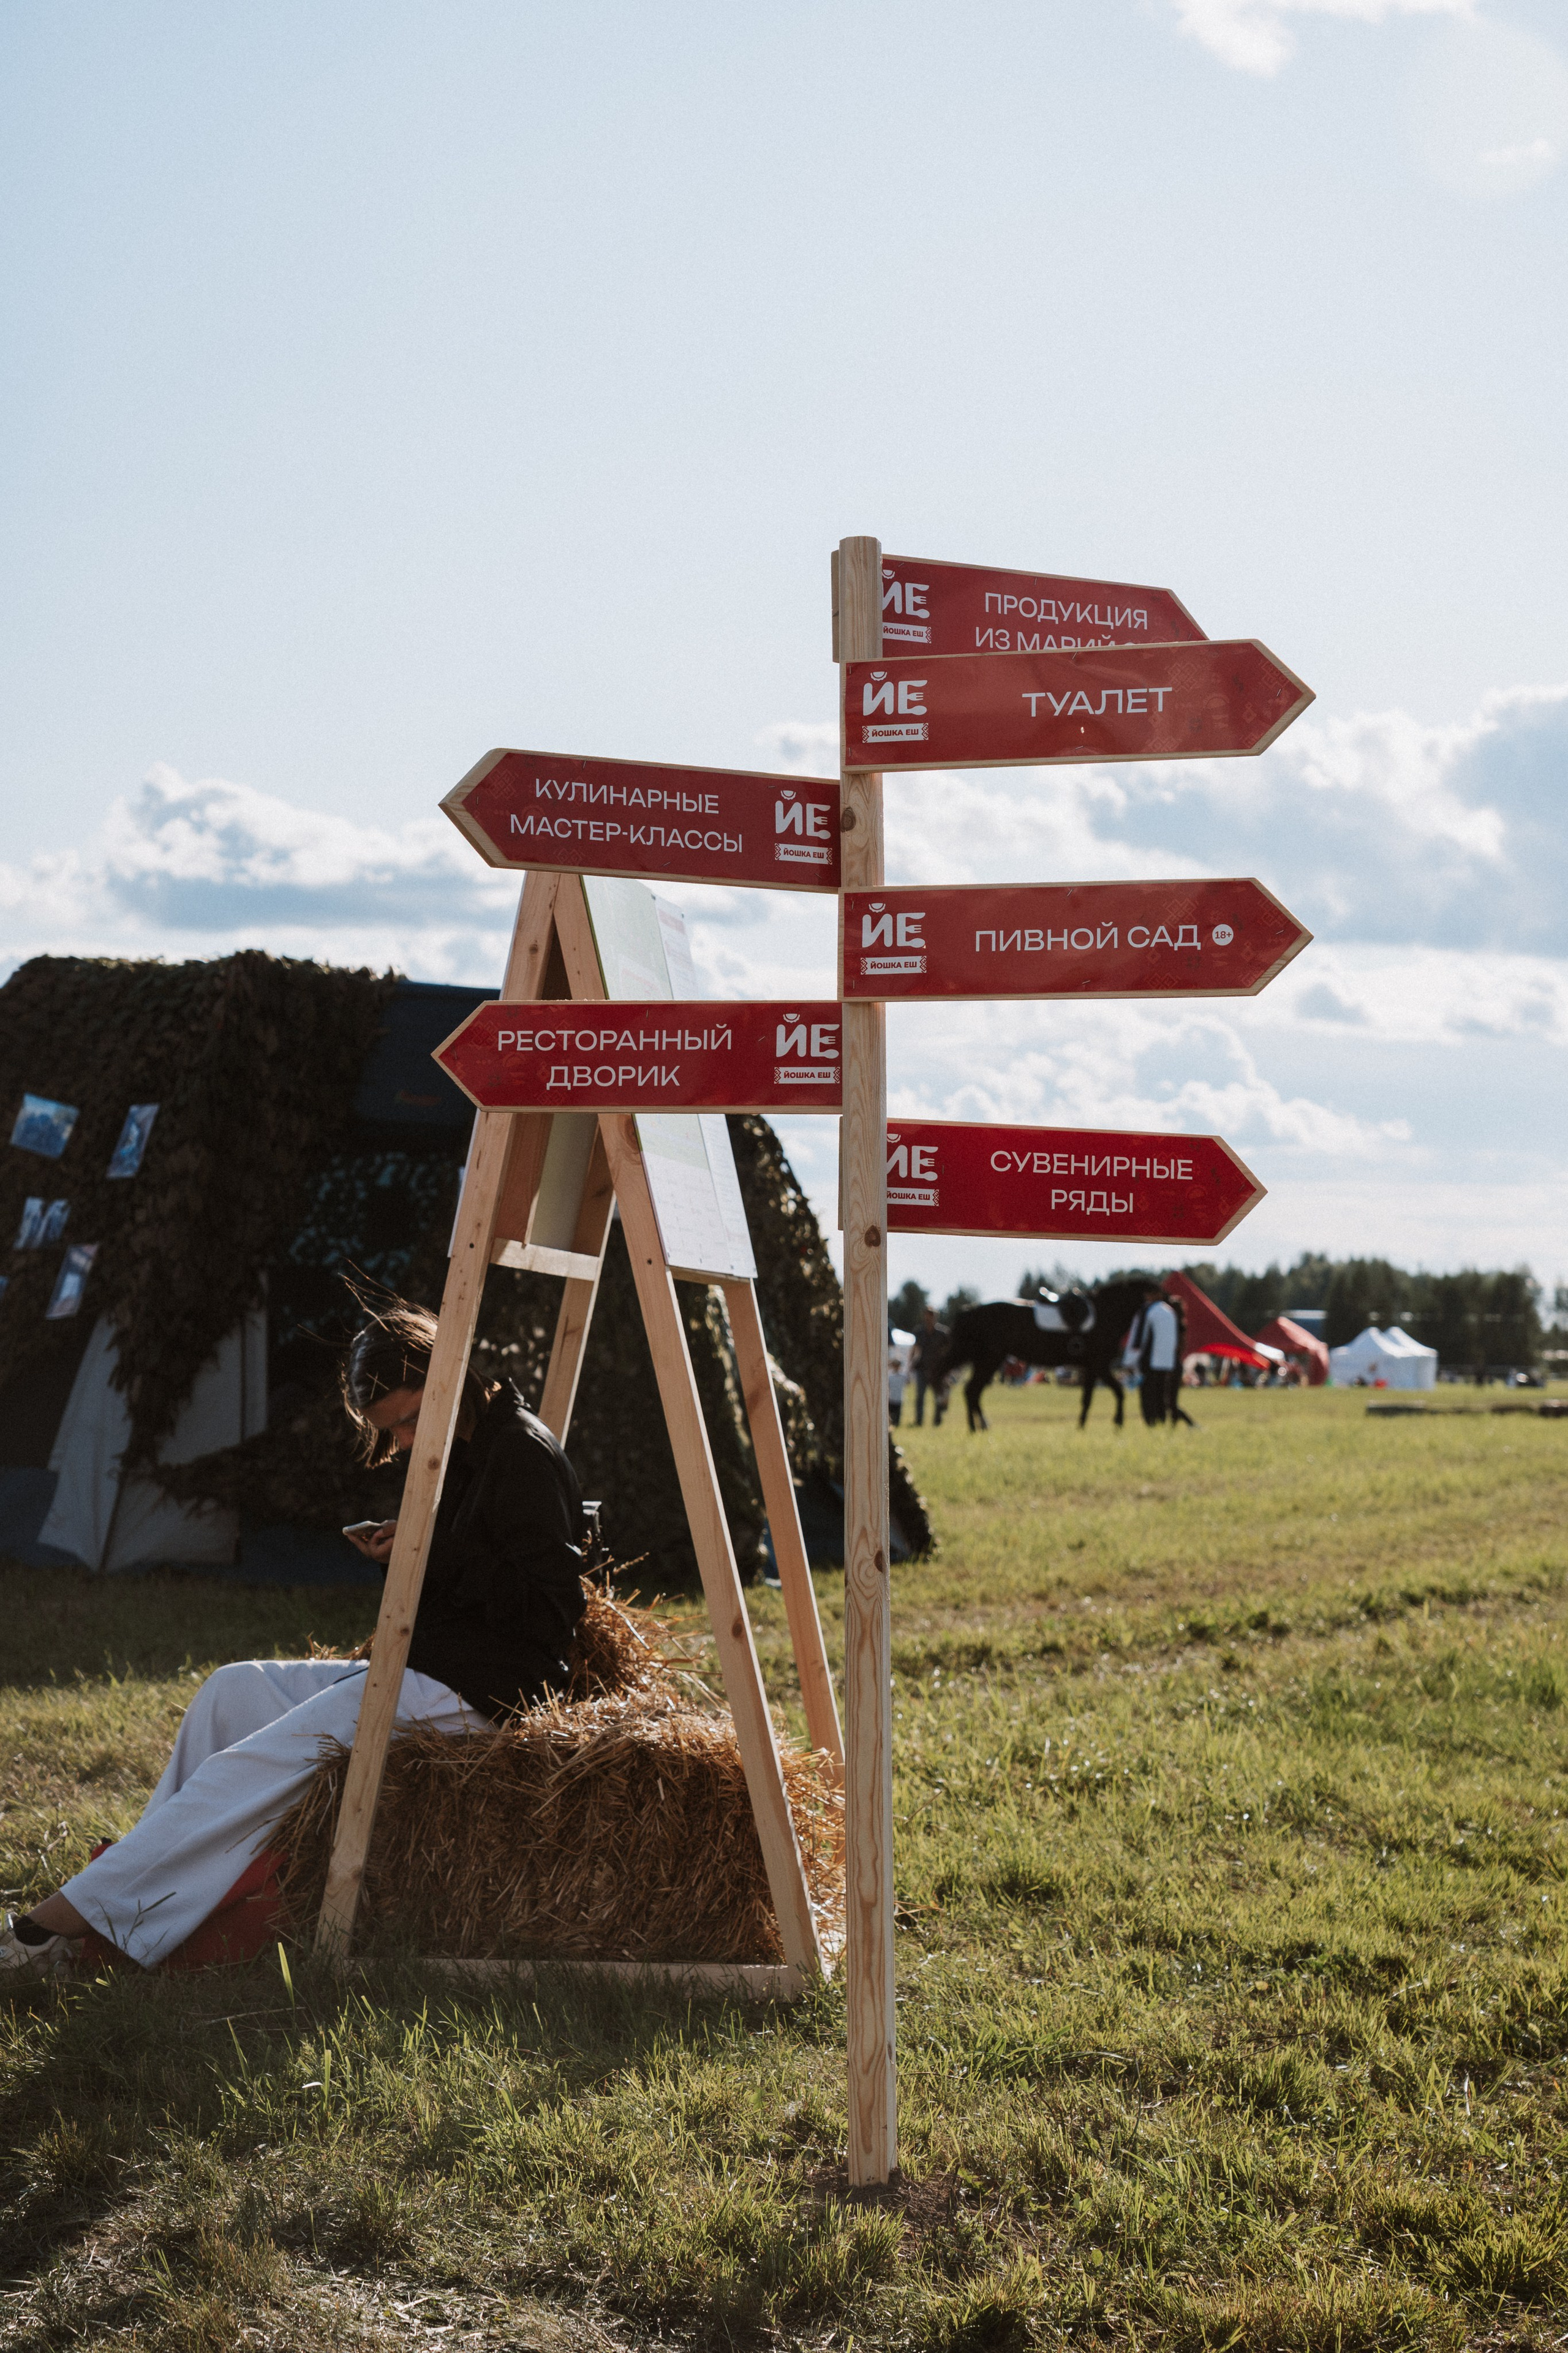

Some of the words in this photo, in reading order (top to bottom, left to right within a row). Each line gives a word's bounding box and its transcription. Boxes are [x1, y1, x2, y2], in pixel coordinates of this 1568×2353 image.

[985, 592, 1148, 630] ПРОДУКЦИЯ
[883, 626, 911, 636] ЙОШКА
[975, 626, 1011, 650] ИЗ
[863, 671, 927, 716] ЙЕ
[1022, 687, 1172, 717] ТУАЛЕТ
[872, 729, 903, 738] ЙОШКА
[535, 778, 719, 814] КУЛИНАРНЫЕ
[775, 790, 831, 839] ЙЕ
[511, 814, 742, 852] МАСТЕР-КЛАССЫ
[783, 847, 811, 858] ЙОШКА
[862, 903, 925, 948] ЙЕ
[976, 922, 1117, 951] ПИВНОЙ
[1128, 925, 1200, 950] САД
[1215, 931, 1232, 939] 18+
[870, 961, 902, 969] ЙОШКА
[499, 1024, 731, 1051] РЕСТОРАННЫЙ
[776, 1014, 839, 1059] ЙЕ
[546, 1066, 680, 1090] ДВОРИК
[783, 1070, 816, 1079] ЙОШКА
[991, 1150, 1193, 1179] СУВЕНИРНЫЕ
[887, 1191, 916, 1200] ЙОШКА
[1052, 1190, 1133, 1215] РЯДЫ
